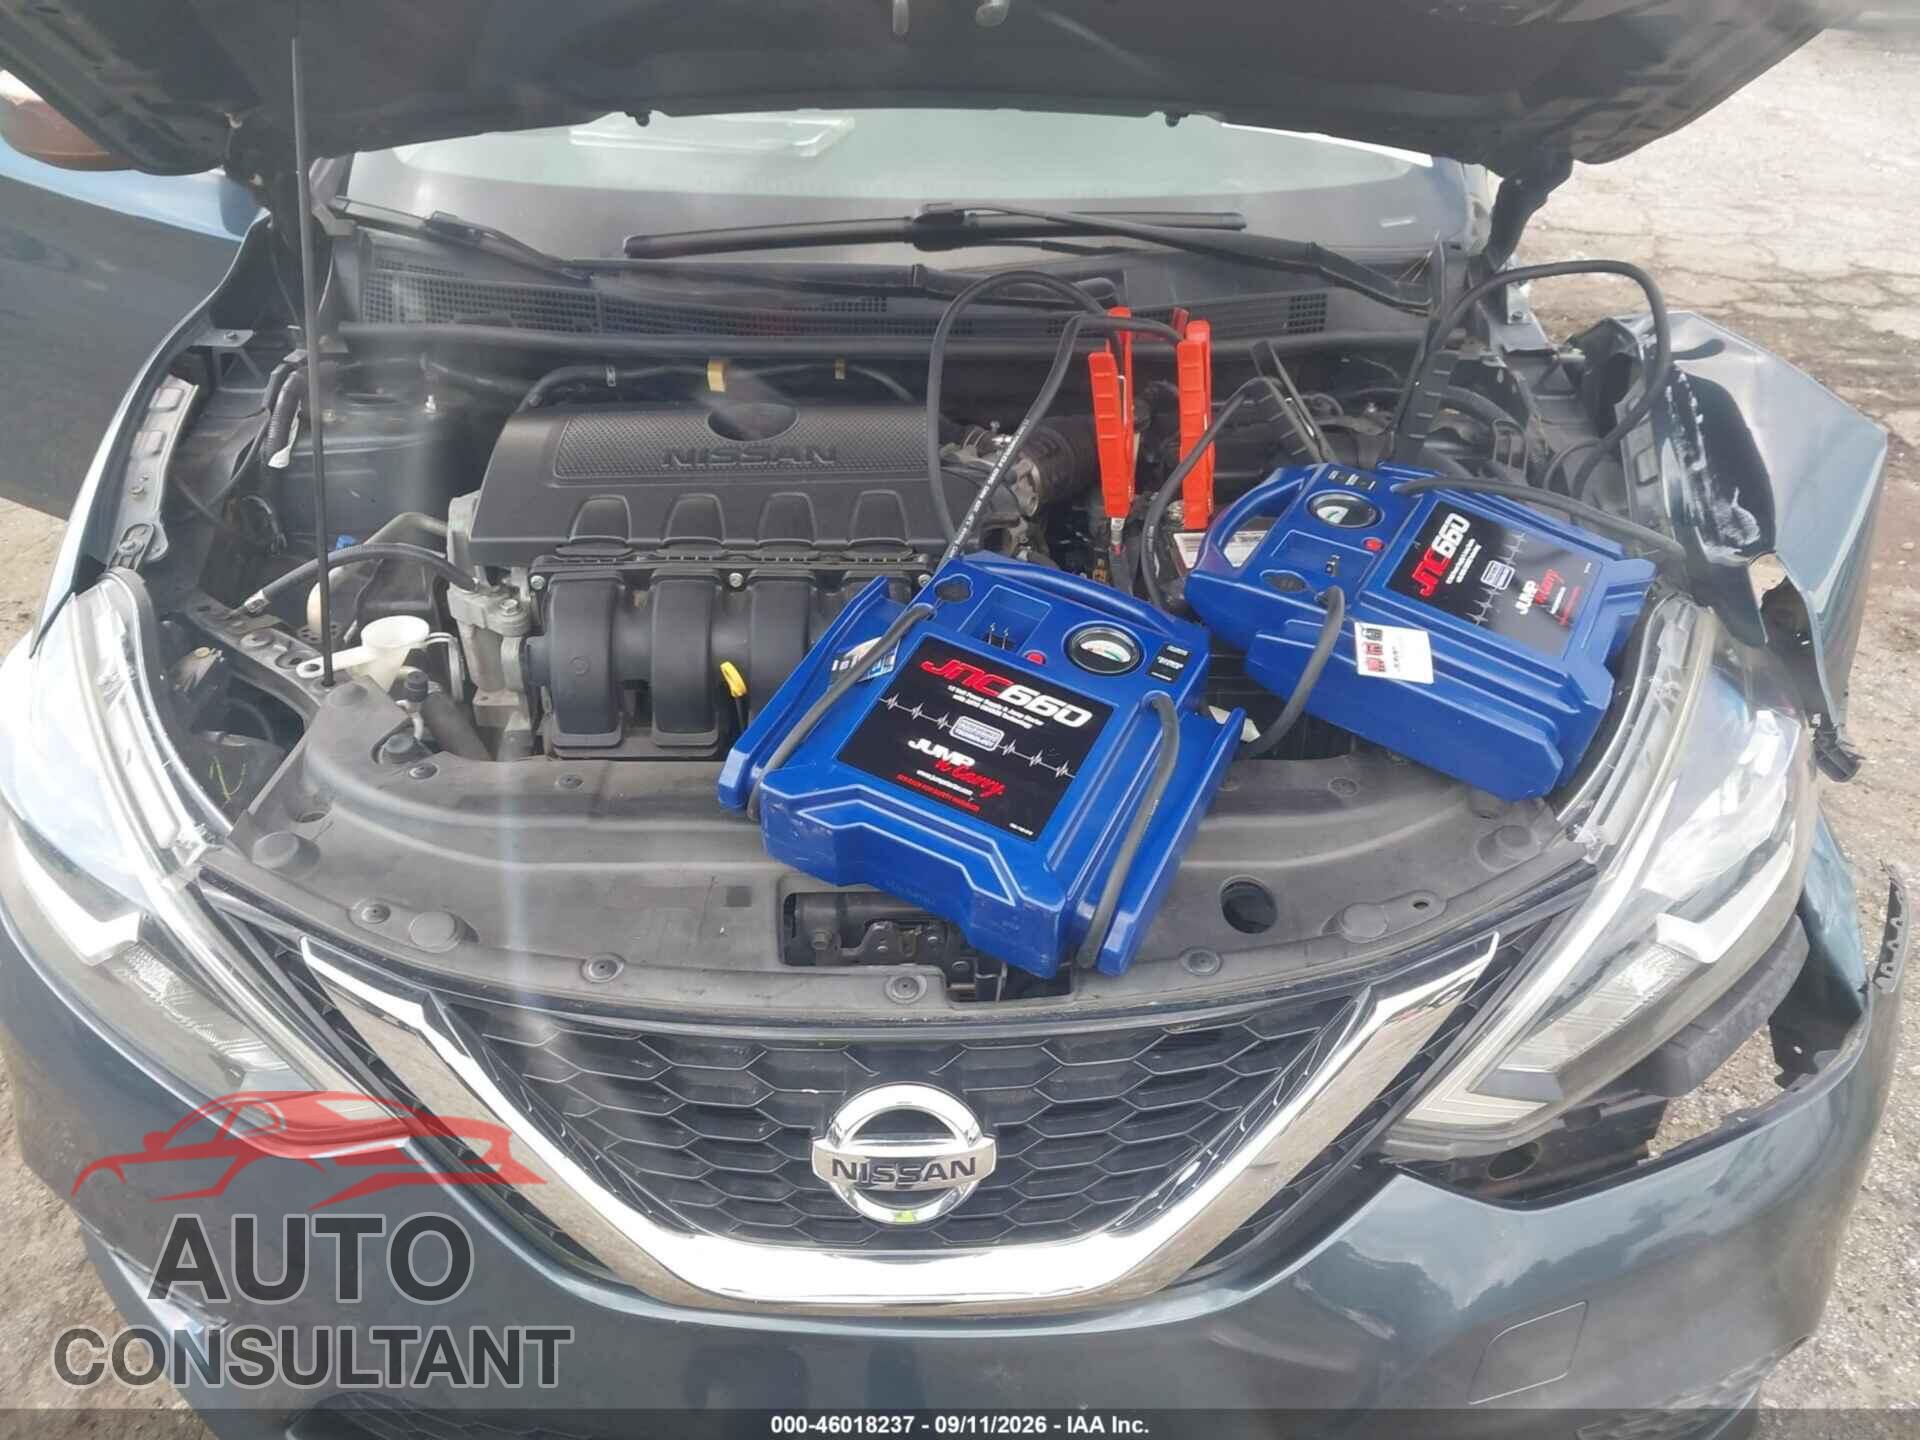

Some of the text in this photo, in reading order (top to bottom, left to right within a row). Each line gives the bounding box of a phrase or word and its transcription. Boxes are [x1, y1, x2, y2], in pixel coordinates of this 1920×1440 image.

[661, 446, 836, 467] NISSAN
[919, 658, 1094, 728] JNC660
[907, 737, 976, 767] JUMP
[831, 1156, 977, 1185] NISSAN
